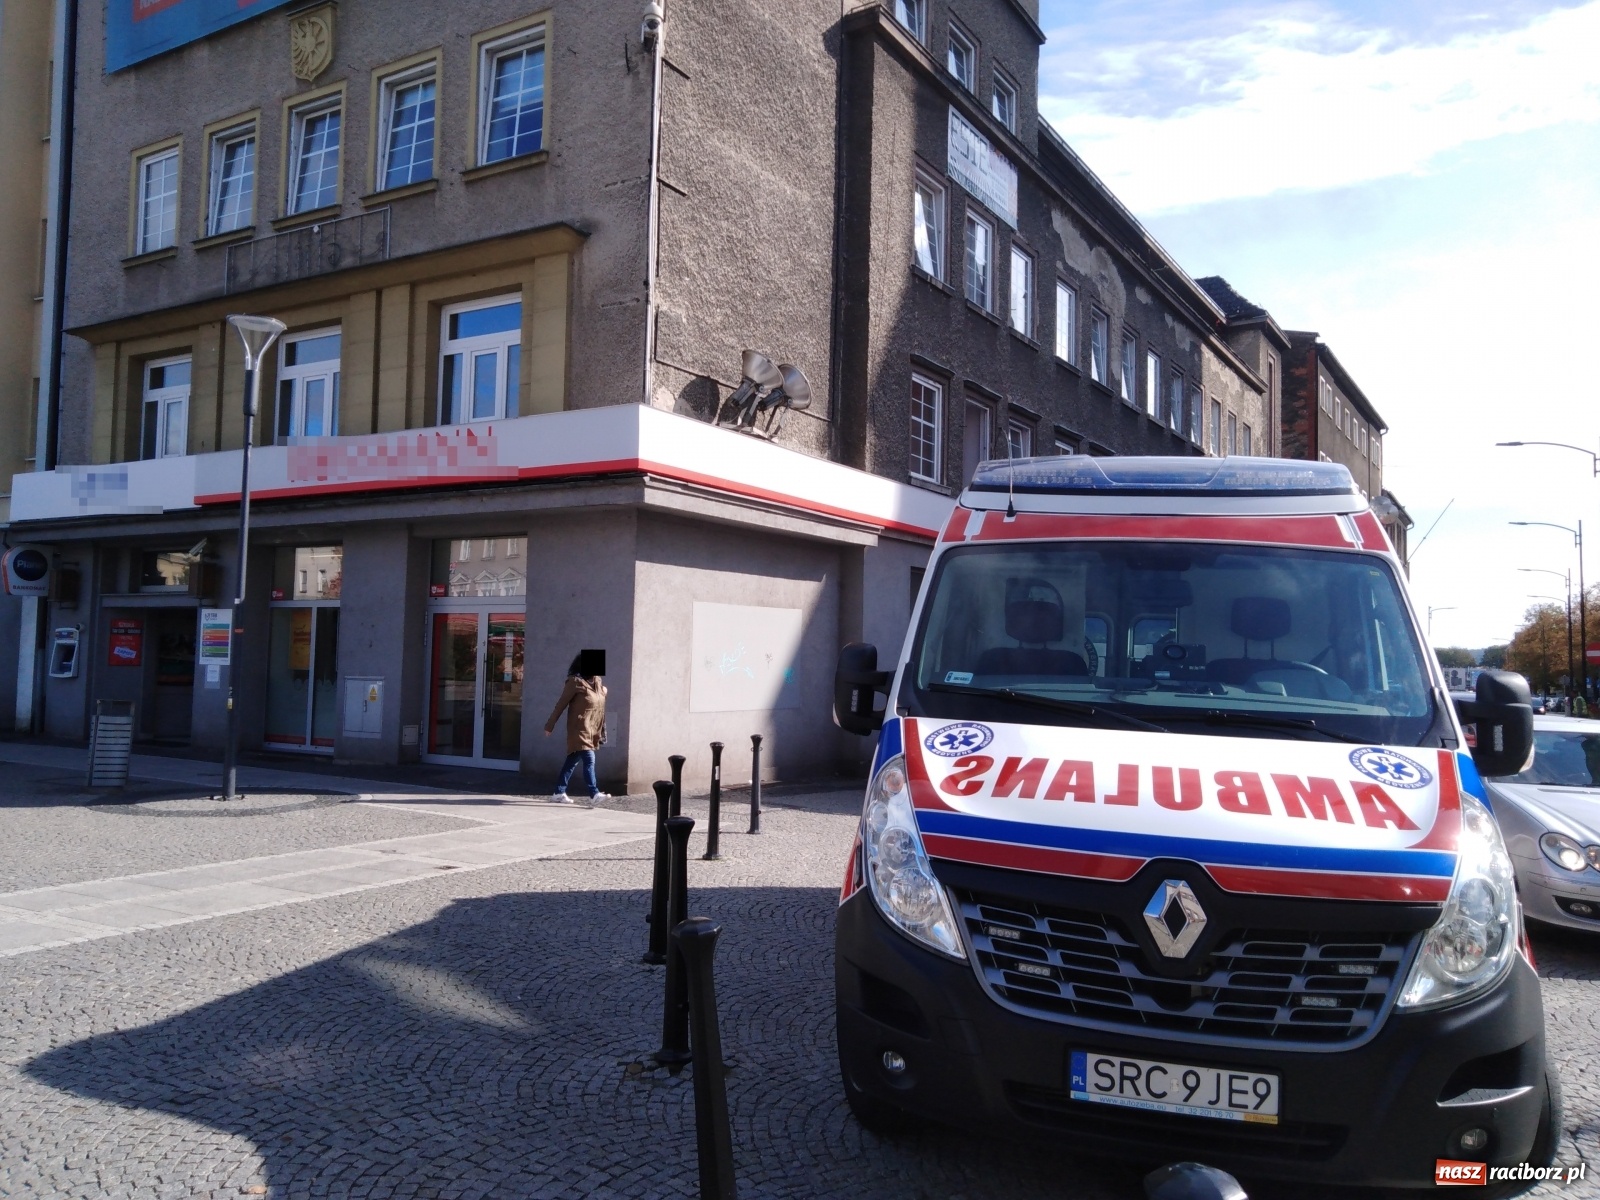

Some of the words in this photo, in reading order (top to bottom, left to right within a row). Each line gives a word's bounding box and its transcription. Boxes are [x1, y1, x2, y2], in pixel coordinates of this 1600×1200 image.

[1072, 1075, 1084, 1086] PL
[1093, 1058, 1169, 1099] SRC
[1182, 1069, 1272, 1111] 9JE9
